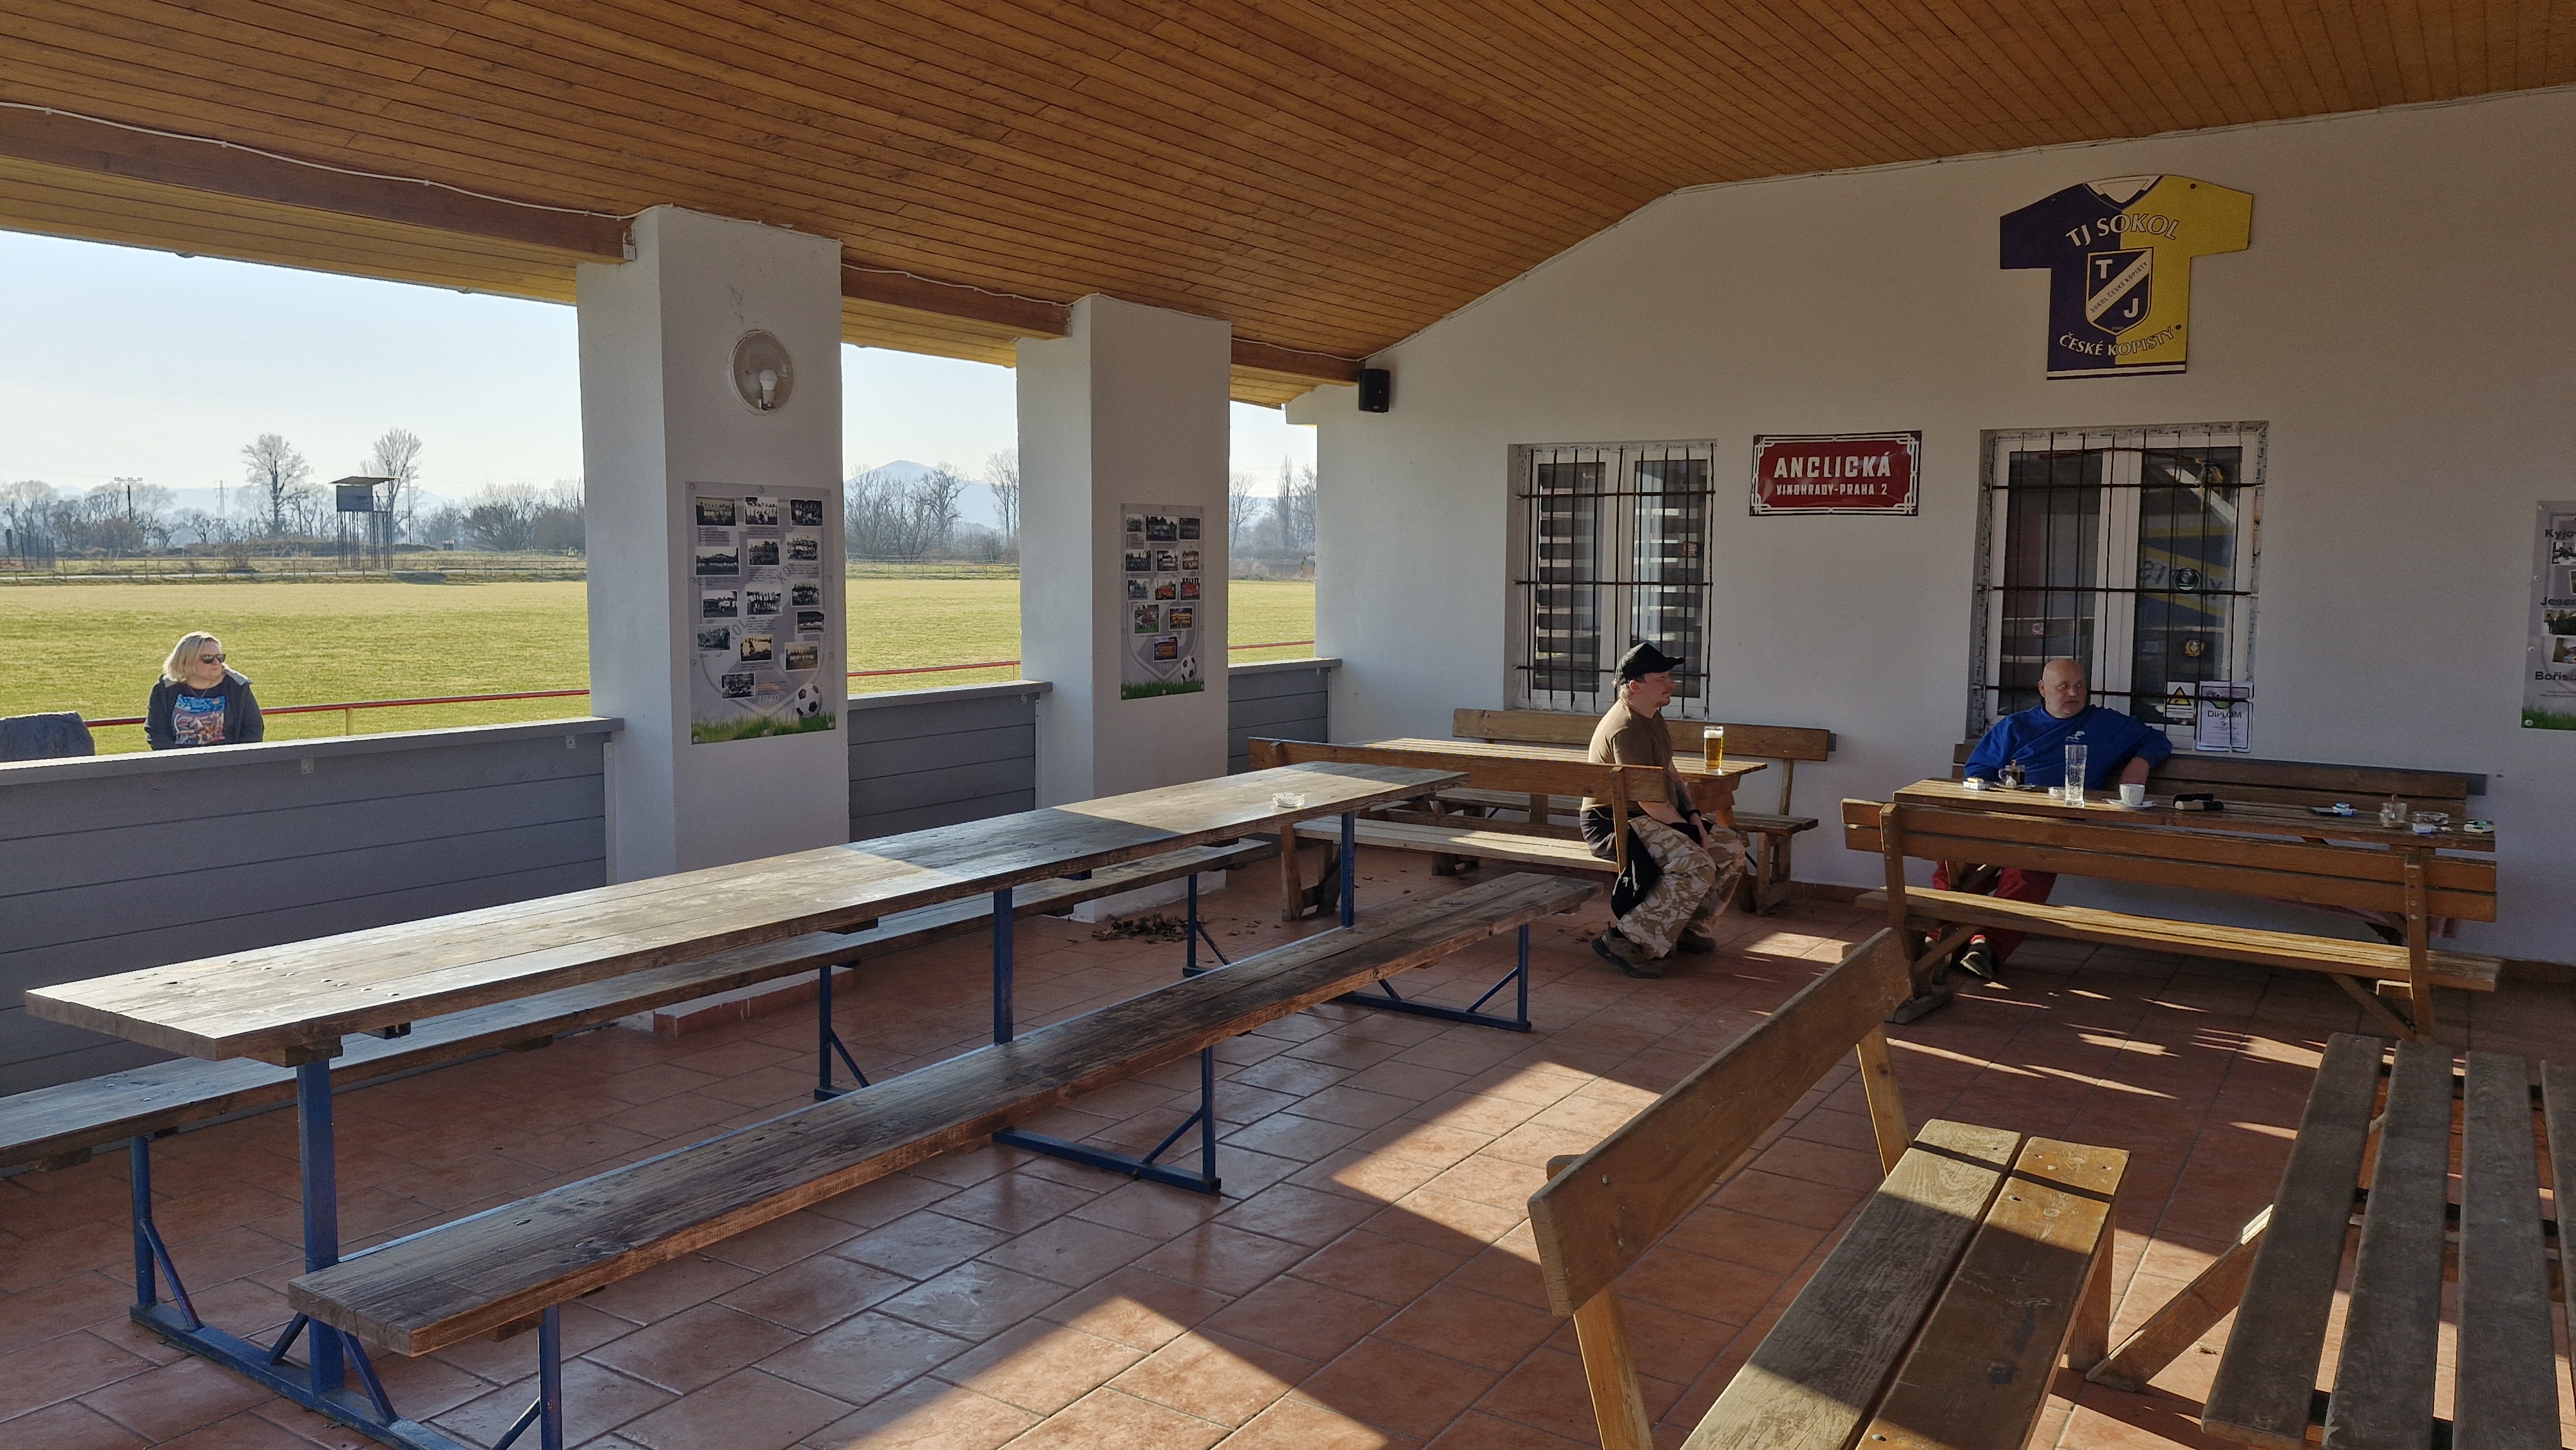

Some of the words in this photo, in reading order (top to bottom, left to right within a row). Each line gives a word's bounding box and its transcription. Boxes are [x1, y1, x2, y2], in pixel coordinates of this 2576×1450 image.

[2065, 224, 2092, 247] TJ
[2097, 213, 2180, 241] SOKOL
[2095, 259, 2113, 279] T
[2090, 297, 2108, 313] SOKOL
[2125, 261, 2148, 283] KOPISTY
[2123, 297, 2139, 318] J
[2059, 331, 2104, 357] ČESKÉ
[2107, 326, 2175, 356] KOPISTY
[1881, 483, 1888, 496] 2
[2207, 710, 2242, 719] DIPLOM
